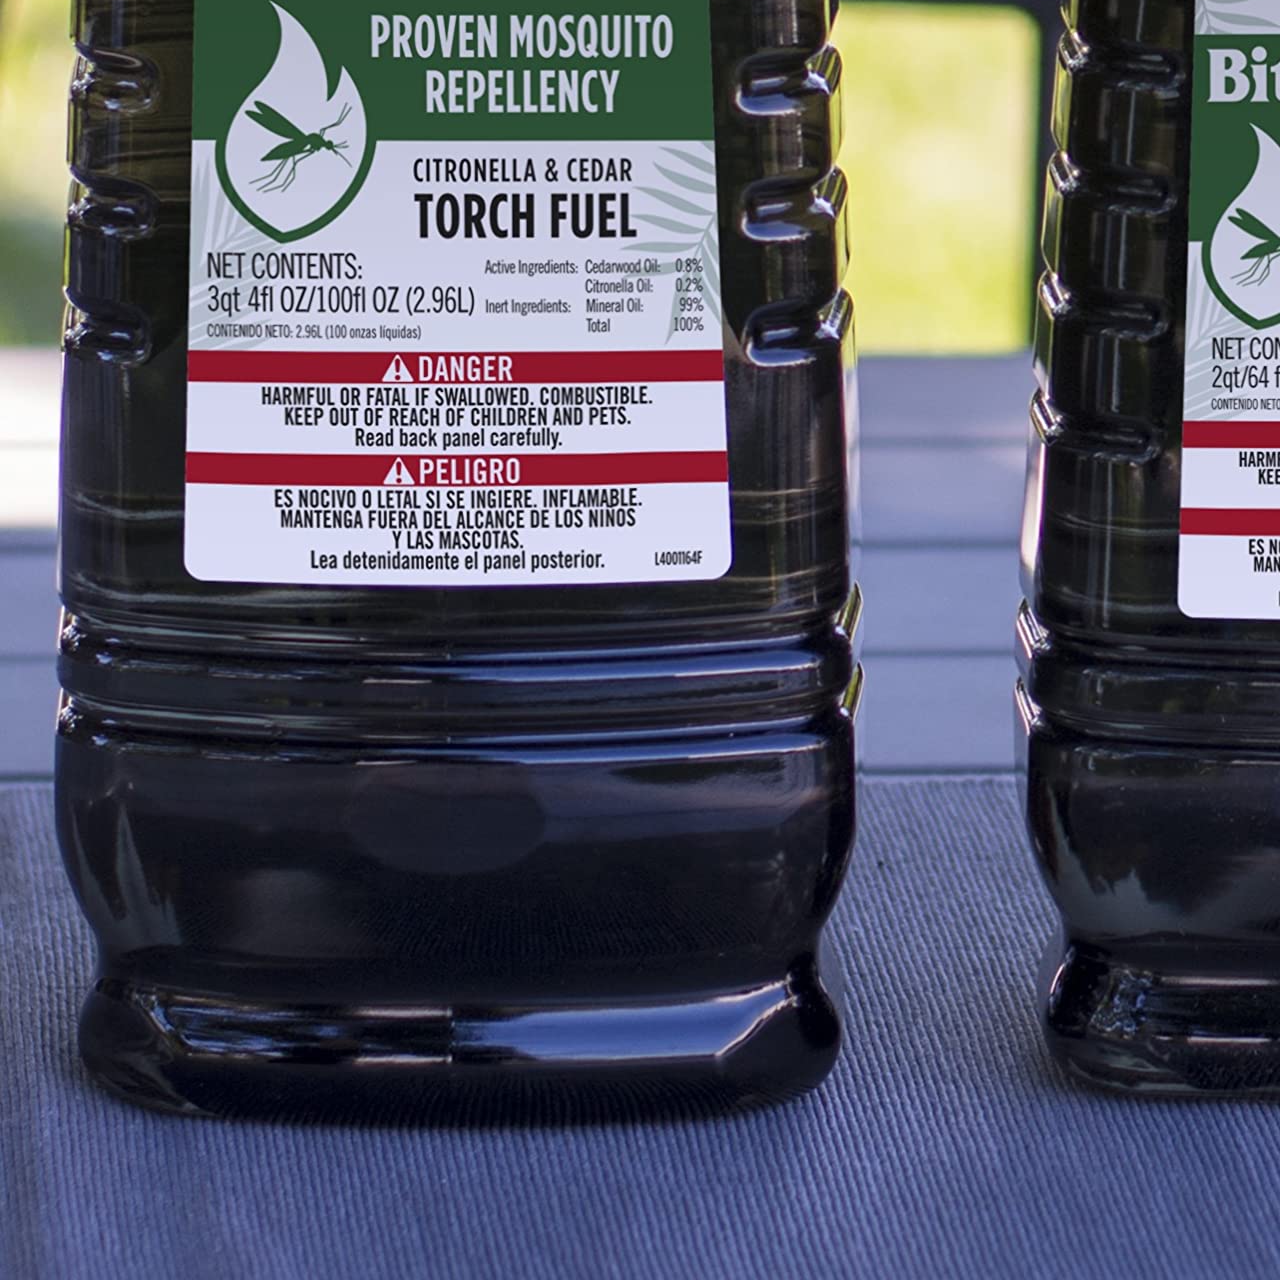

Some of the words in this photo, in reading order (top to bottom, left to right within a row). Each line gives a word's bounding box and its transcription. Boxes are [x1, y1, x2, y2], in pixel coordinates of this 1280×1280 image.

[371, 15, 497, 58] PROVEN
[510, 14, 673, 58] MOSQUITO
[426, 70, 619, 113] REPELLENCY
[413, 158, 536, 182] CITRONELLA
[545, 158, 558, 182] &
[567, 158, 632, 182] CEDAR
[414, 193, 534, 239] TORCH
[551, 193, 637, 238] FUEL
[207, 252, 246, 279] NET
[251, 252, 362, 279] CONTENTS:
[208, 286, 240, 317] 3qt
[373, 286, 399, 313] OZ
[406, 286, 474, 316] (2.96L)
[1212, 337, 1245, 360] NET
[419, 356, 512, 381] DANGER
[1212, 365, 1269, 390] 2qt/64
[262, 387, 335, 405] HARMFUL
[340, 387, 360, 406] OR
[367, 388, 409, 406] FATAL
[415, 388, 429, 406] IF
[435, 387, 534, 406] SWALLOWED.
[540, 386, 652, 405] COMBUSTIBLE.
[285, 407, 324, 426] KEEP
[329, 408, 358, 426] OUT
[364, 408, 383, 426] OF
[389, 408, 439, 426] REACH
[446, 408, 465, 426] OF
[471, 408, 547, 426] CHILDREN
[553, 407, 583, 425] AND
[589, 407, 631, 425] PETS.
[355, 428, 393, 446] Read
[400, 428, 437, 447] back
[443, 428, 484, 449] panel
[490, 428, 562, 449] carefully.
[420, 458, 520, 484] PELIGRO
[275, 489, 293, 508] ES
[299, 490, 356, 508] NOCIVO
[362, 490, 371, 508] O
[378, 490, 421, 508] LETAL
[426, 490, 440, 508] SI
[447, 490, 465, 508] SE
[471, 490, 537, 508] INGIERE.
[393, 531, 401, 549] Y
[407, 531, 433, 549] LAS
[439, 531, 523, 549] MASCOTAS.
[311, 550, 337, 569] Lea
[343, 551, 459, 570] detenidamente
[465, 551, 478, 570] el
[484, 550, 525, 571] panel
[531, 550, 604, 571] posterior.
[655, 551, 702, 566] L4001164F
